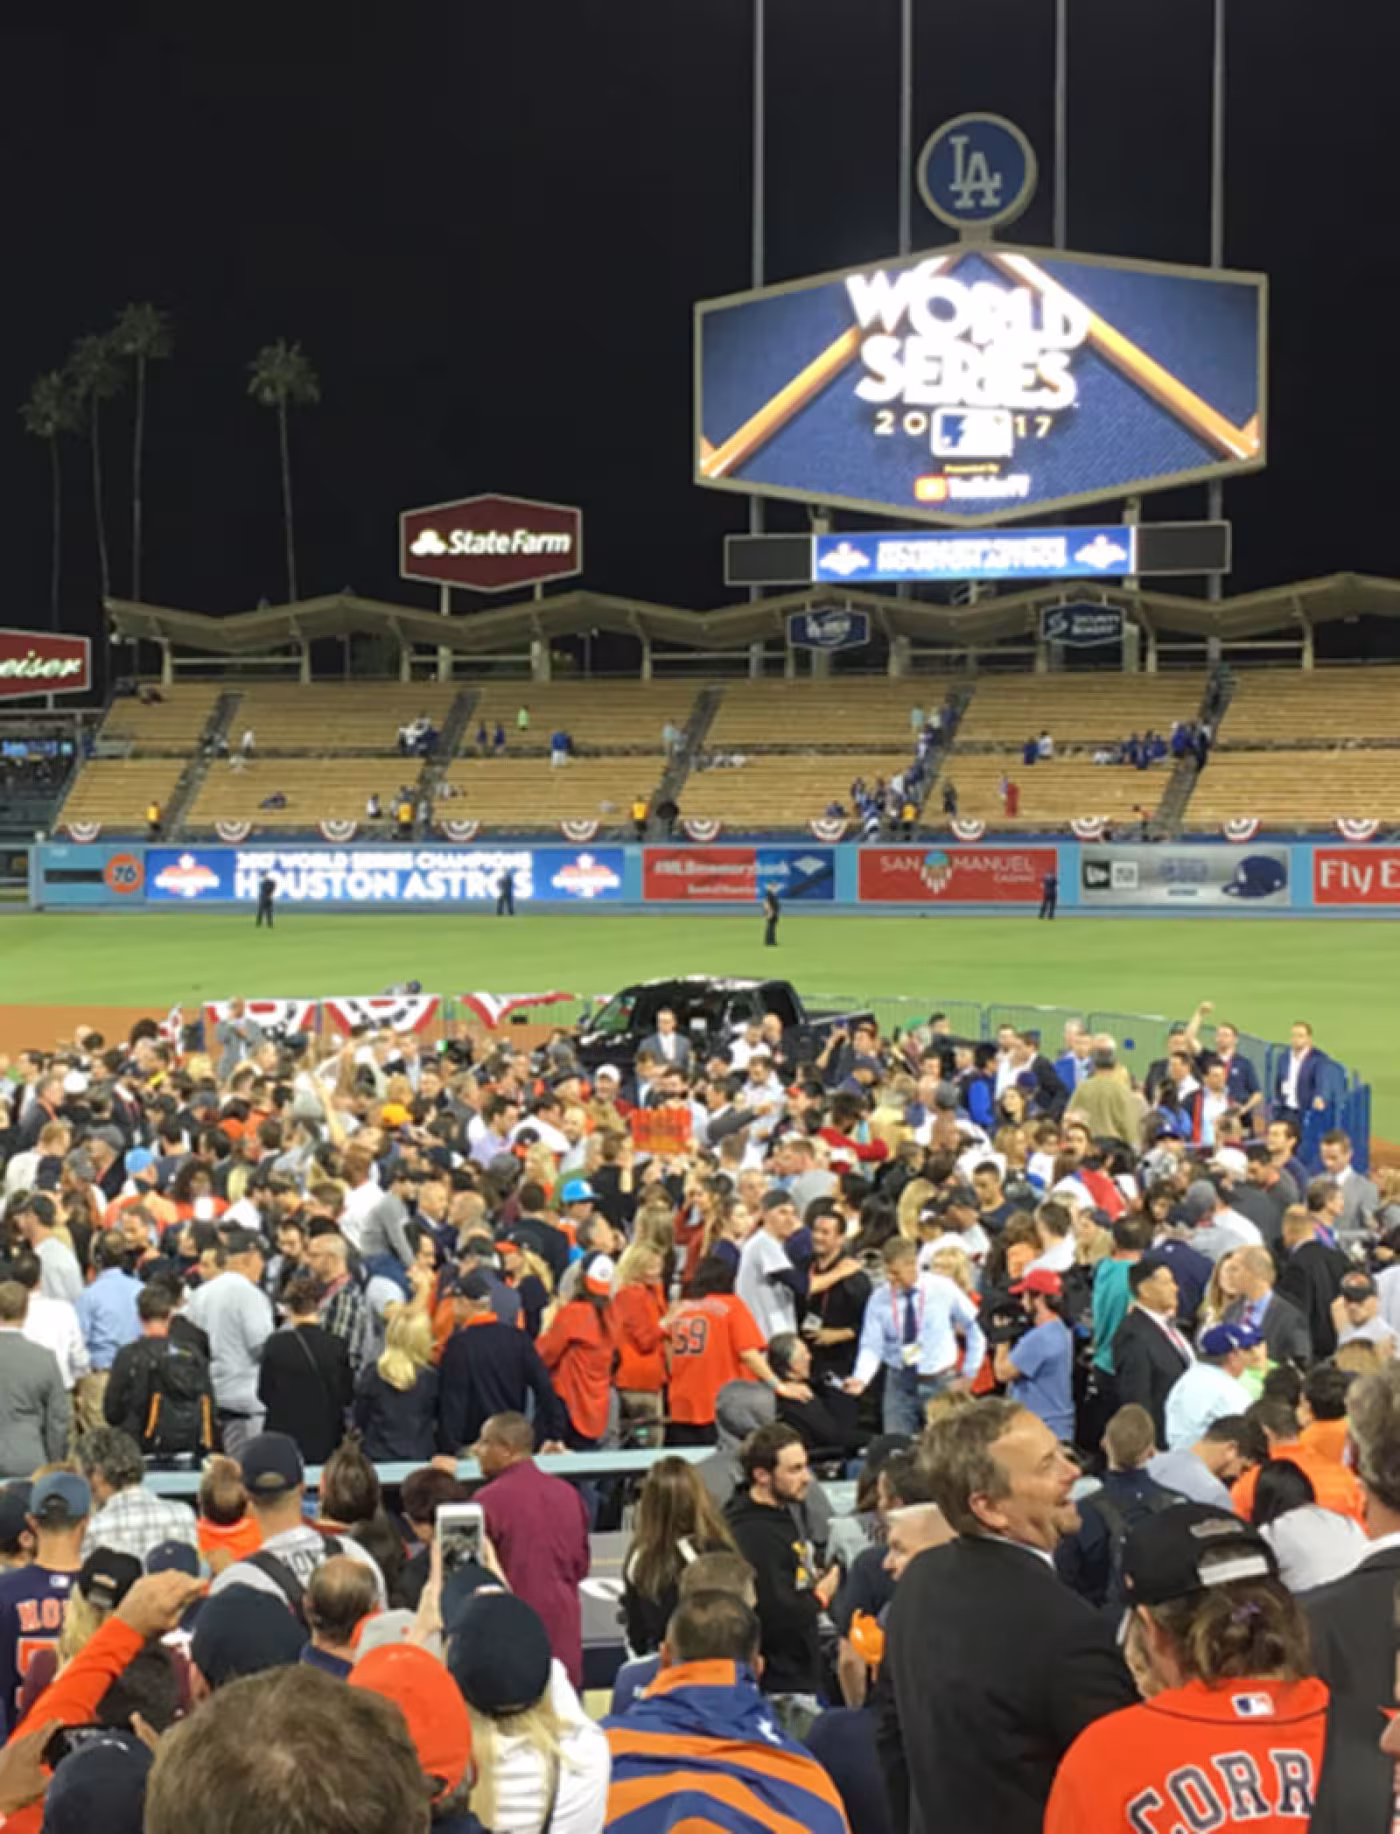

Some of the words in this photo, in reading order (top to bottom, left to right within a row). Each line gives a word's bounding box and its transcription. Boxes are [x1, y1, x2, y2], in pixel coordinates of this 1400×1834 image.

[949, 136, 1001, 208] LA
[845, 270, 1090, 350] WORLD
[853, 334, 1077, 410] SERIES
[112, 865, 137, 882] 76
[880, 855, 920, 872] SAN
[952, 855, 1034, 872] MANUEL
[1320, 859, 1373, 895] Fly
